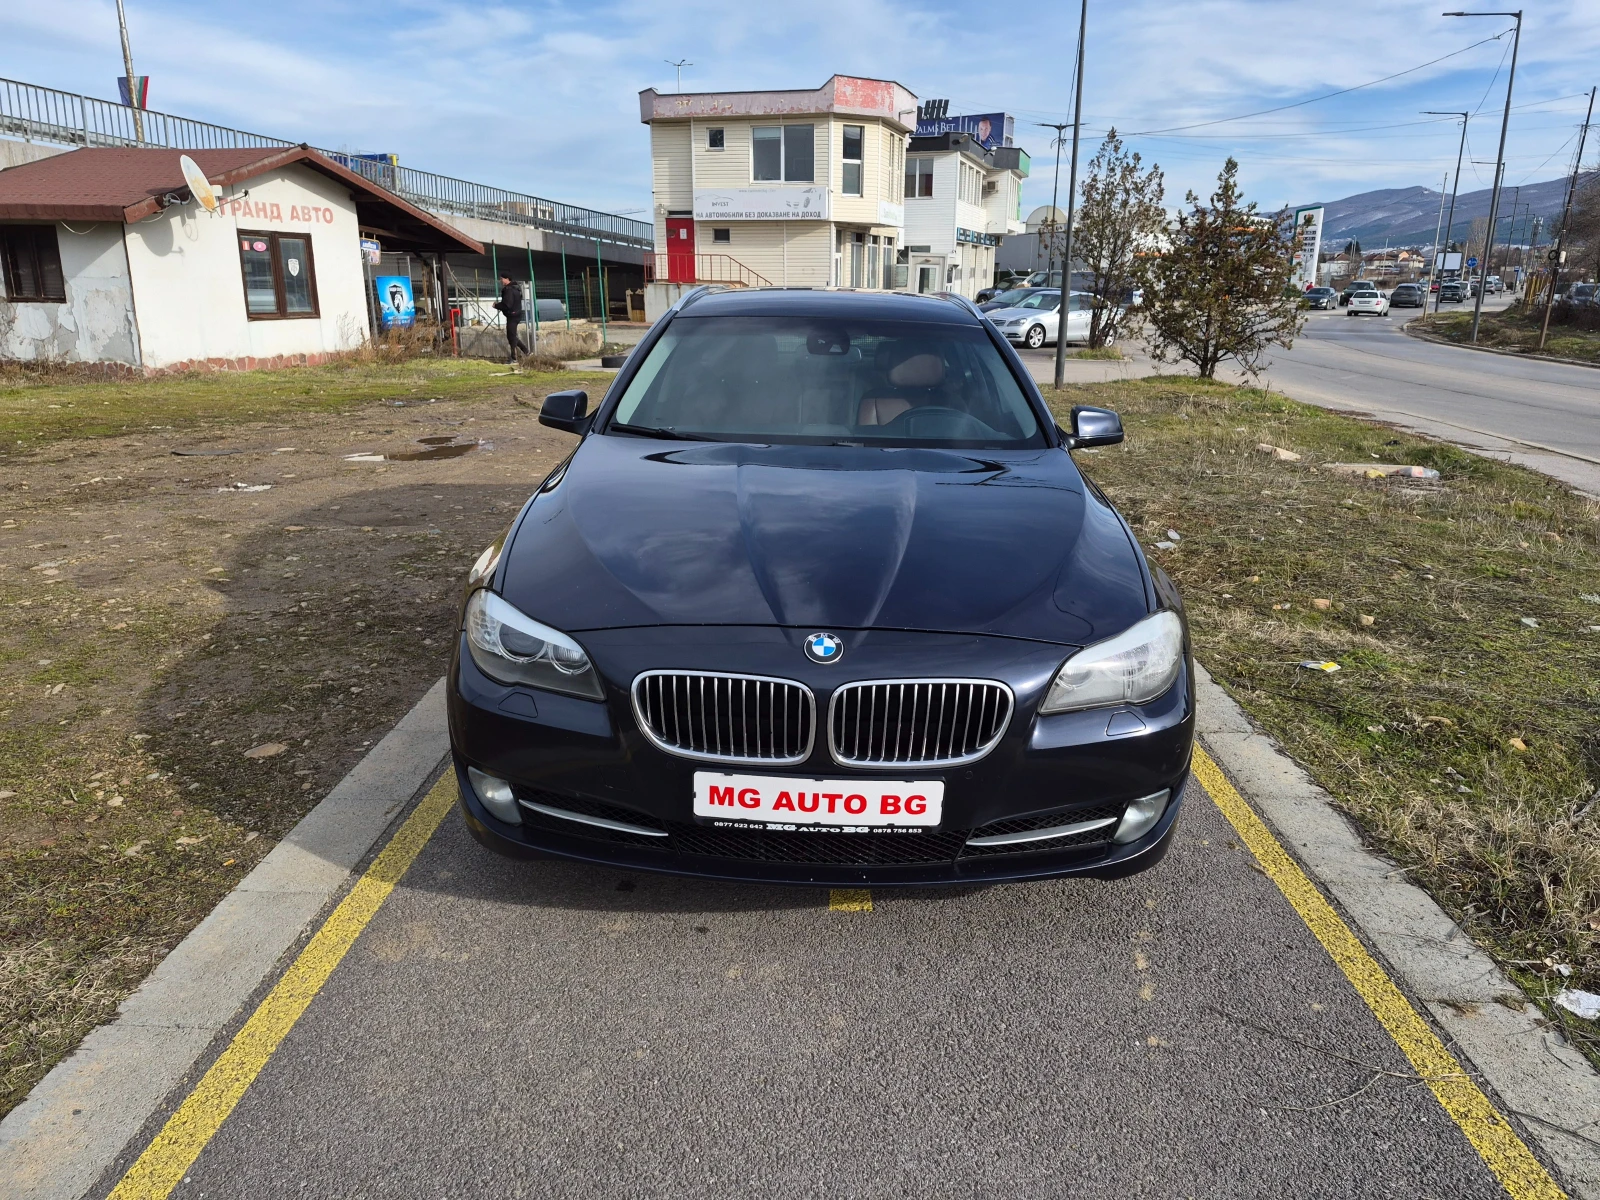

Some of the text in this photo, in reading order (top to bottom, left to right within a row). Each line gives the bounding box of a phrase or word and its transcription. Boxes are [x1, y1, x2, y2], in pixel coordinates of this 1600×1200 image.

[914, 122, 955, 133] PALMS BET
[218, 197, 334, 224] ГРАНД АВТО
[791, 210, 800, 218] НА
[801, 210, 822, 218] ДОХОД
[709, 785, 927, 815] MG AUTO BG
[766, 823, 797, 831] MG
